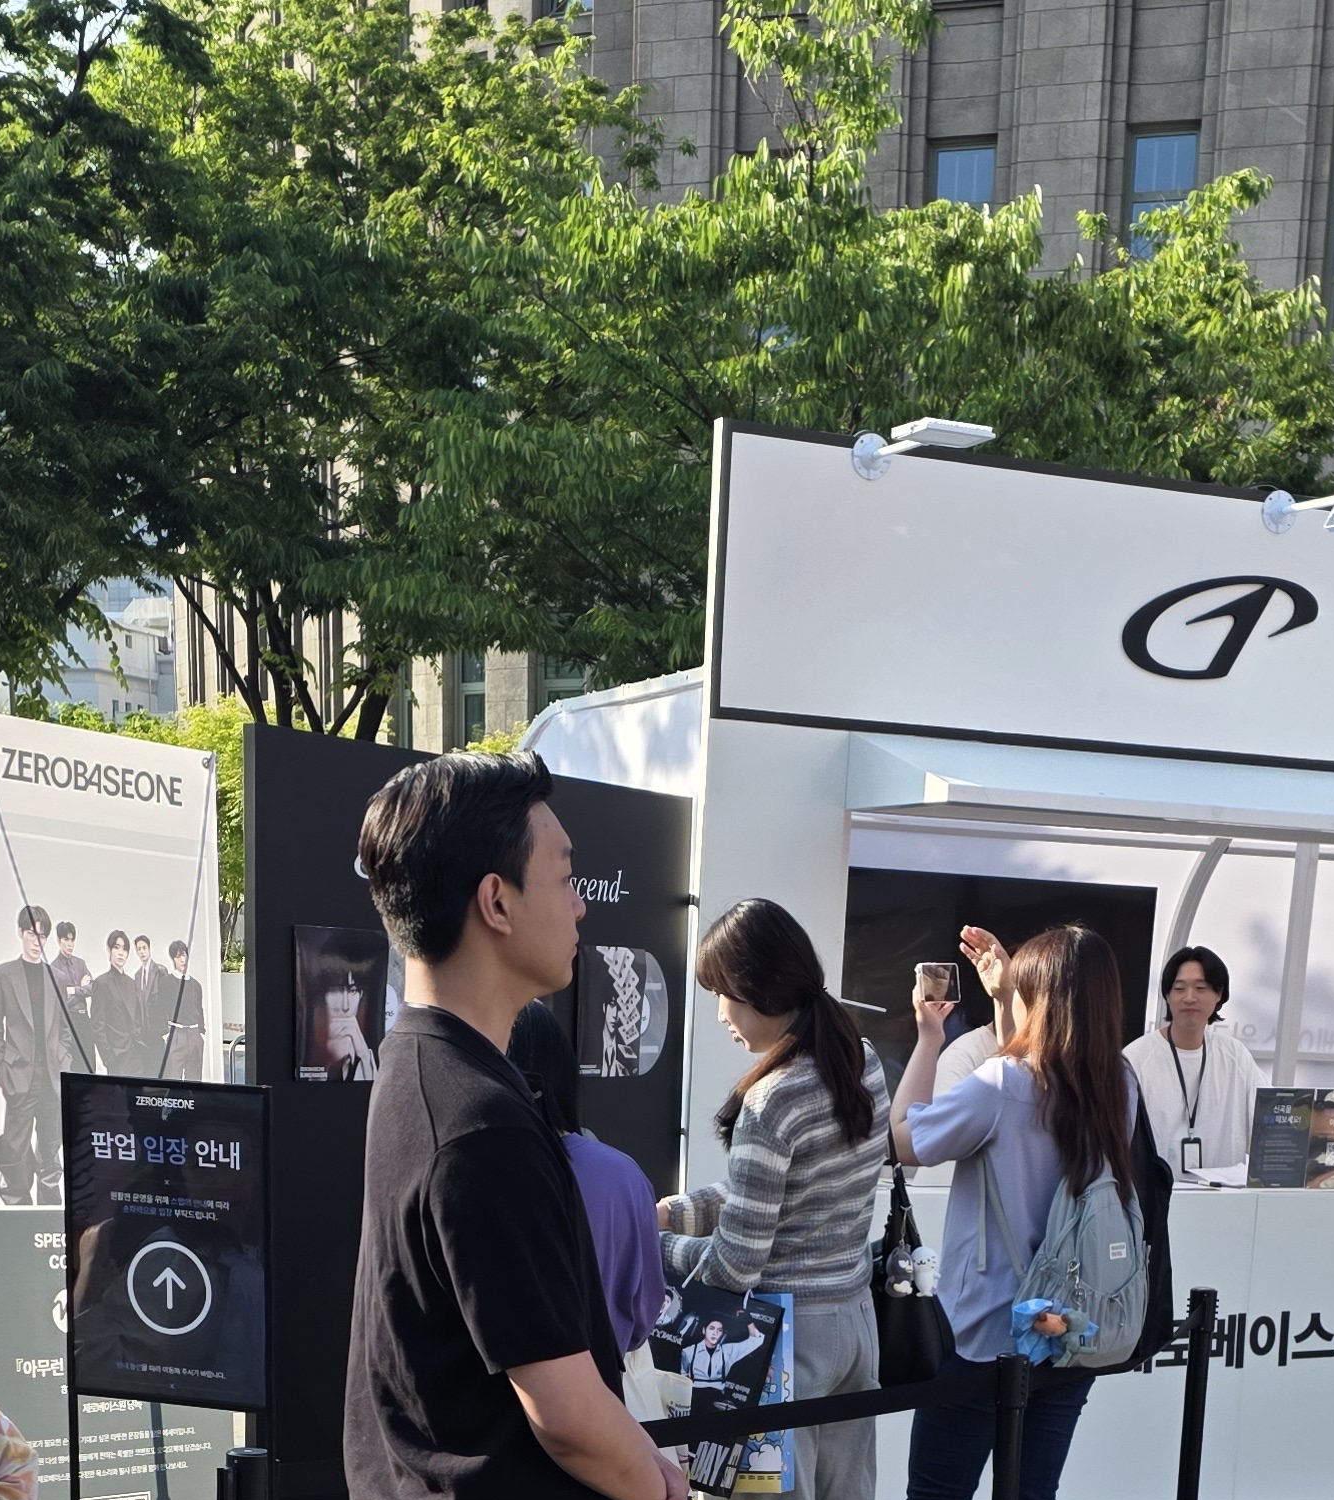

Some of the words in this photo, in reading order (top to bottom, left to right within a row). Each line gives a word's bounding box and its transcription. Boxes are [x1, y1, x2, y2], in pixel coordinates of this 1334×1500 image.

[91, 1131, 136, 1161] 팝업
[143, 1136, 188, 1165] 입장
[195, 1139, 241, 1171] 안내
